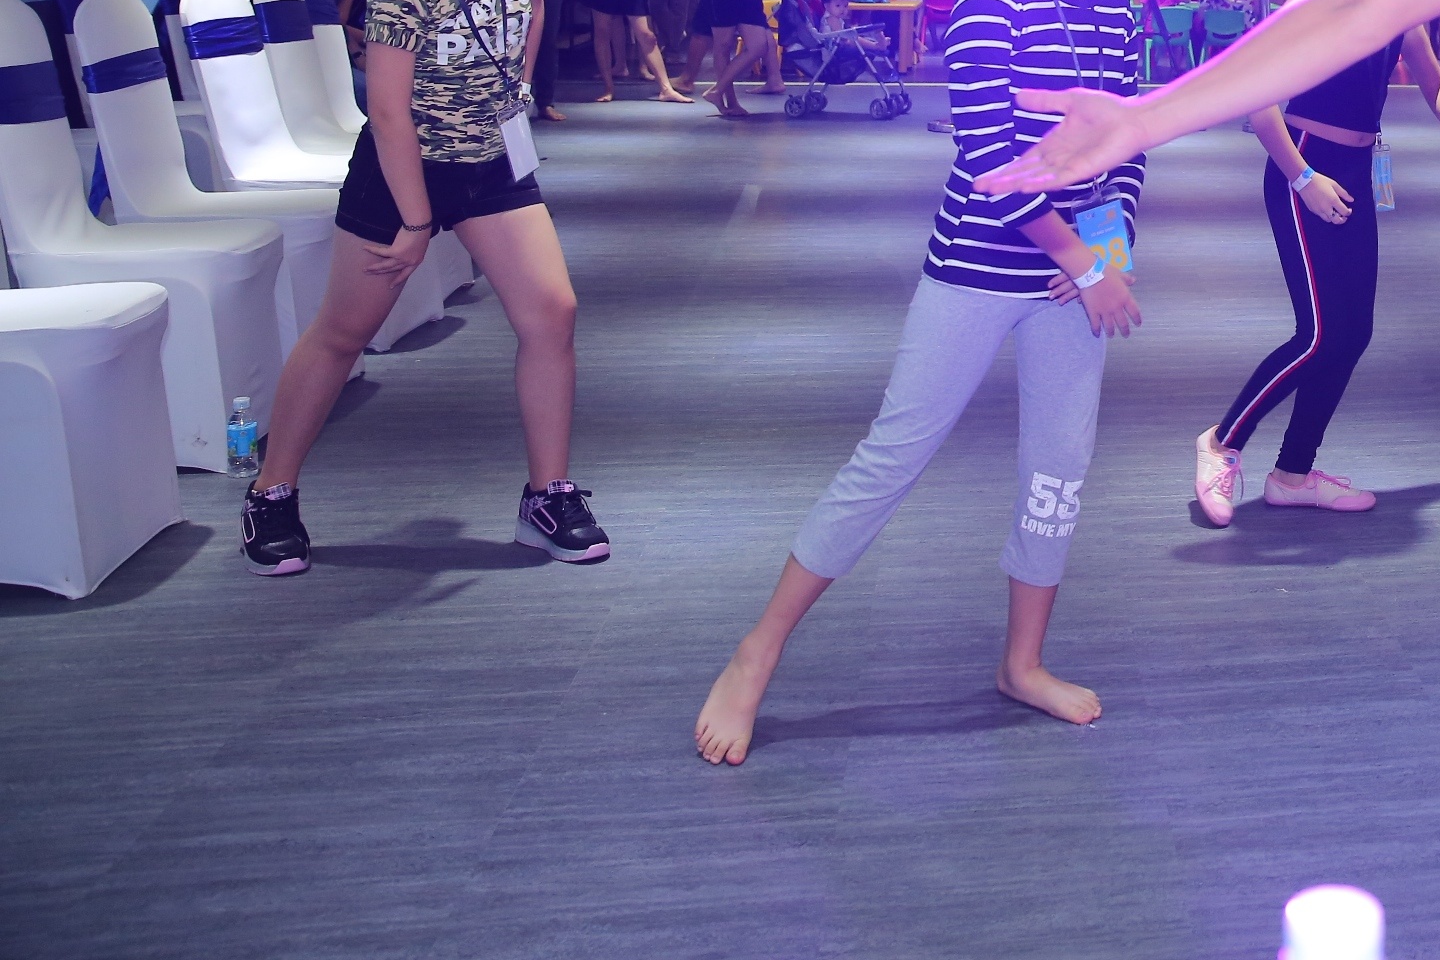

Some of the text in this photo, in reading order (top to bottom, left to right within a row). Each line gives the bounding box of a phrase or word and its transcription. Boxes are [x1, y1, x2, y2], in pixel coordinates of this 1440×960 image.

[436, 12, 531, 66] PARI
[1027, 471, 1085, 520] 55
[1021, 514, 1057, 538] LOVE
